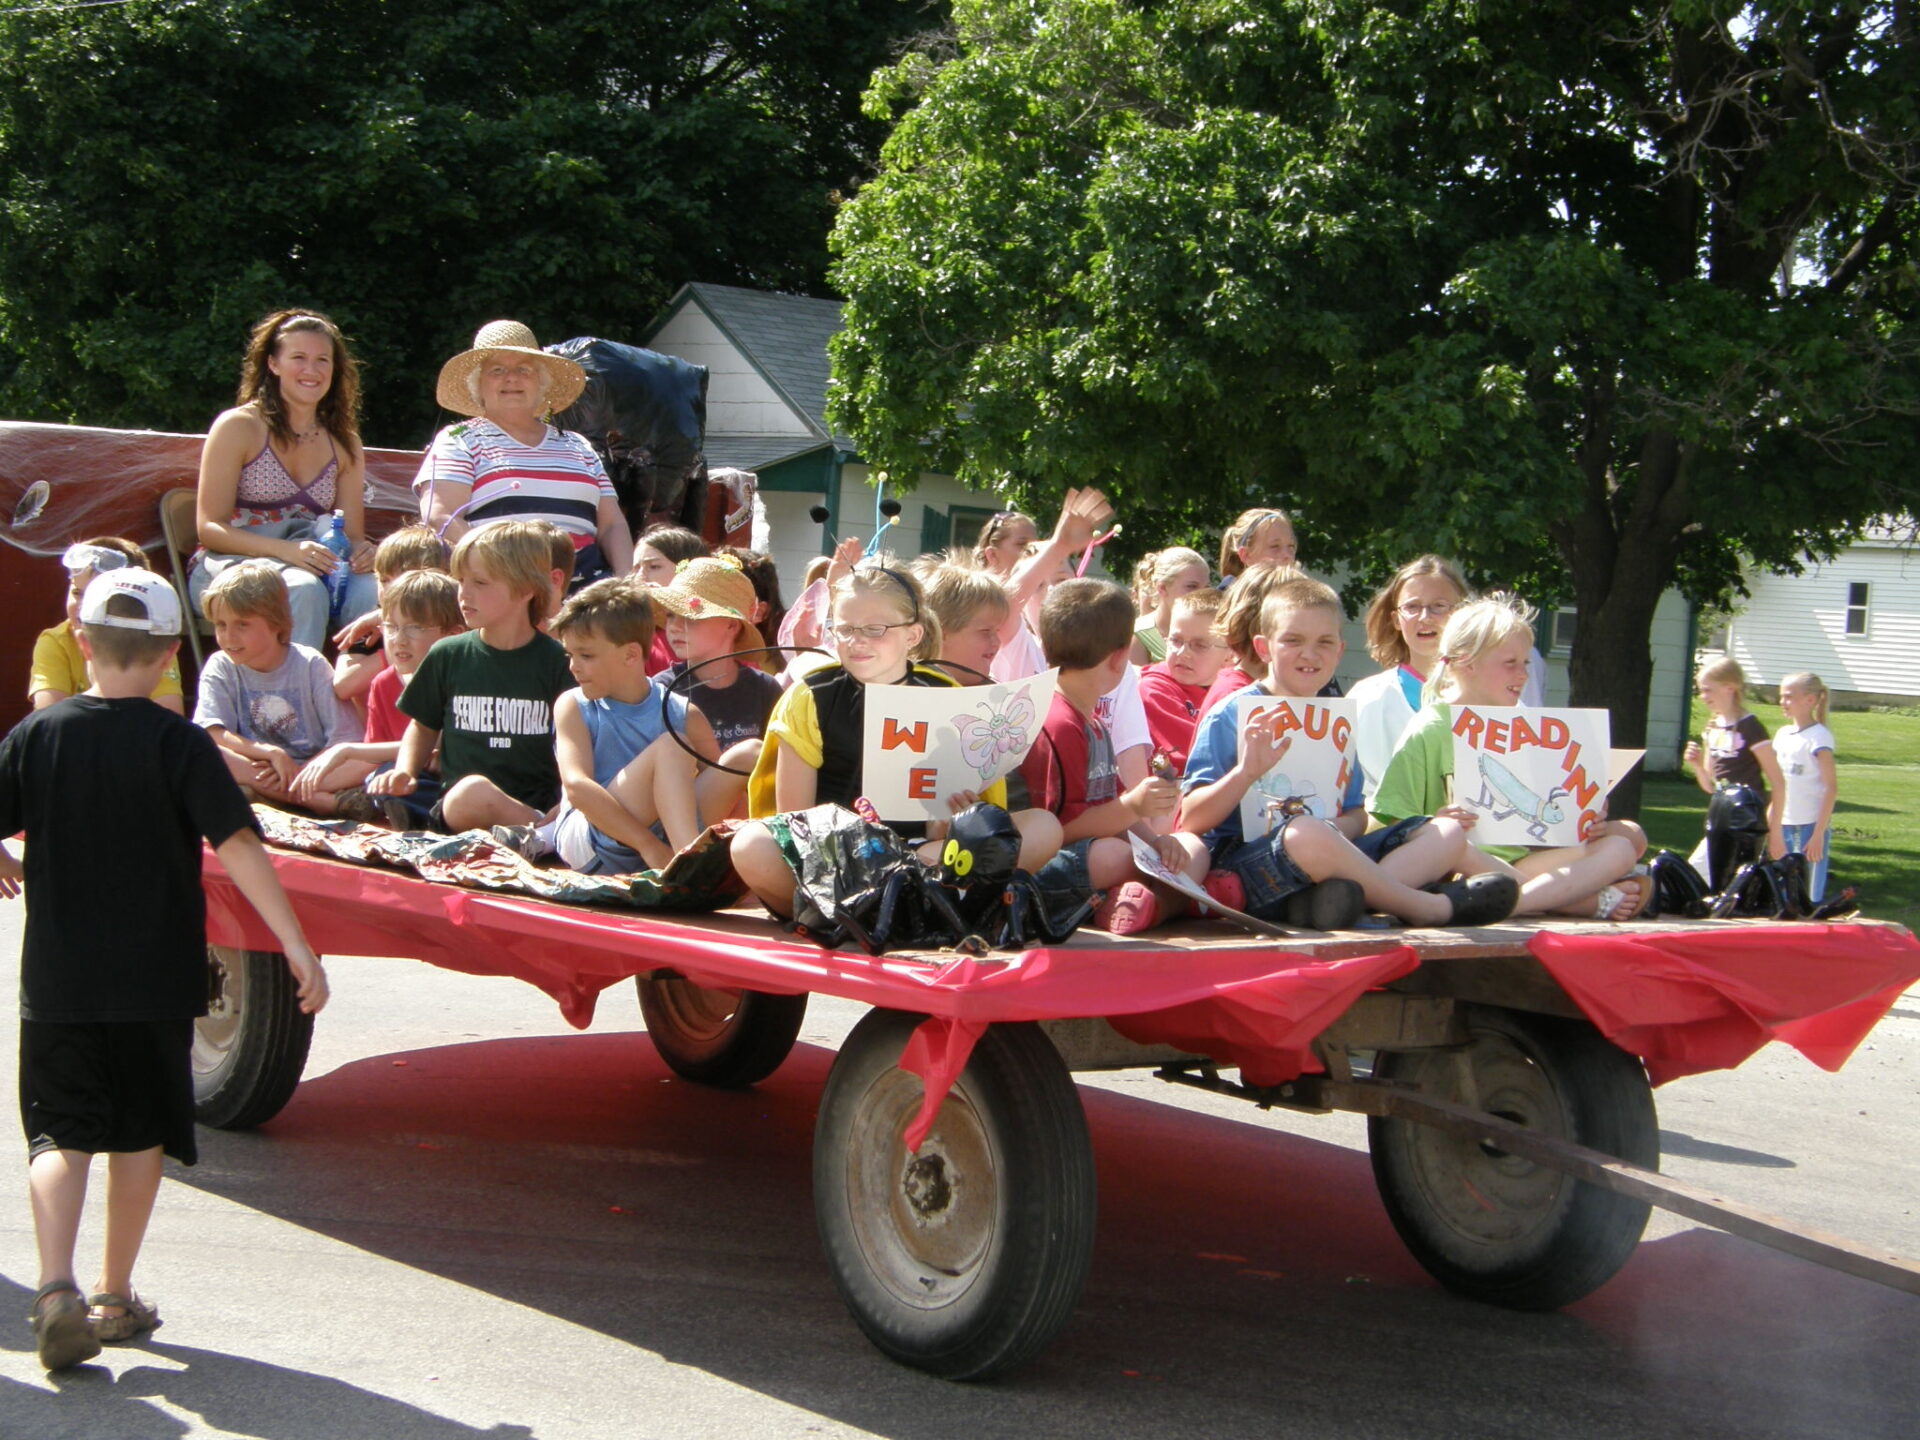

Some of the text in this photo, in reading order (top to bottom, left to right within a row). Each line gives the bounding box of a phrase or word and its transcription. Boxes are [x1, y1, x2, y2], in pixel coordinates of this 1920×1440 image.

[453, 695, 549, 735] PEEWEE FOOTBALL
[489, 737, 511, 748] IPRD
[1452, 706, 1600, 842] READING
